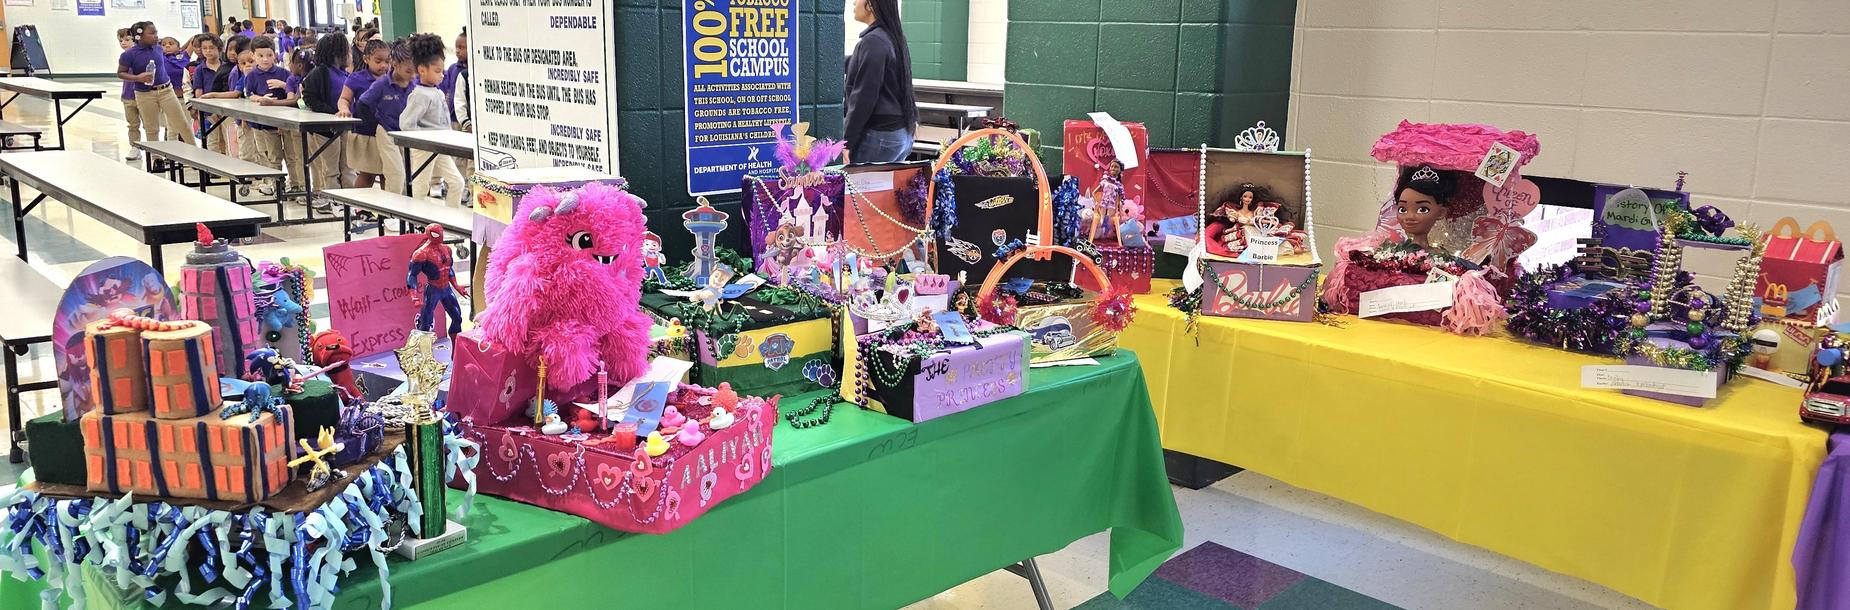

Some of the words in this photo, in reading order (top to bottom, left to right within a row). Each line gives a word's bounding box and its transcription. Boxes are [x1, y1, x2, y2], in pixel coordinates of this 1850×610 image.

[550, 16, 597, 29] DEPENDABLE
[729, 7, 789, 37] FREE
[483, 46, 494, 60] WALK
[496, 47, 502, 61] TO
[503, 47, 512, 62] THE
[513, 48, 522, 62] BUS
[523, 48, 530, 63] OR
[532, 48, 560, 66] DESIGNATED
[562, 51, 578, 67] AREA.
[730, 38, 788, 57] SCHOOL
[548, 68, 580, 82] INCREDIBLY
[583, 70, 599, 84] SAFE
[730, 58, 789, 77] CAMPUS
[484, 79, 500, 94] REMAIN
[501, 80, 517, 96] SEATED
[518, 83, 525, 98] ON
[526, 83, 535, 99] THE
[536, 84, 546, 100] BUS
[547, 85, 560, 101] UNTIL
[562, 86, 571, 103] THE
[574, 88, 584, 104] BUS
[586, 89, 596, 105] HAS
[709, 96, 736, 105] SCHOOL,
[485, 98, 504, 114] STOPPED
[506, 101, 511, 115] AT
[512, 101, 525, 117] YOUR
[526, 103, 535, 118] BUS
[537, 104, 550, 120] STOP.
[694, 109, 726, 117] GROUNDS
[551, 123, 583, 140] INCREDIBLY
[585, 128, 601, 142] SAFE
[694, 121, 732, 130] PROMOTING
[488, 132, 498, 146] KEEP
[499, 132, 509, 149] YOUR
[539, 139, 547, 154] AND
[548, 140, 567, 158] OBJECTS
[568, 143, 574, 158] TO
[710, 133, 748, 141] LOUISIANA'S
[694, 165, 737, 174] DEPARTMENT
[1607, 210, 1638, 223] Mardi
[354, 254, 392, 276] The
[351, 328, 405, 357] Express
[922, 358, 950, 381] THE
[681, 423, 764, 489] AALIYAH
